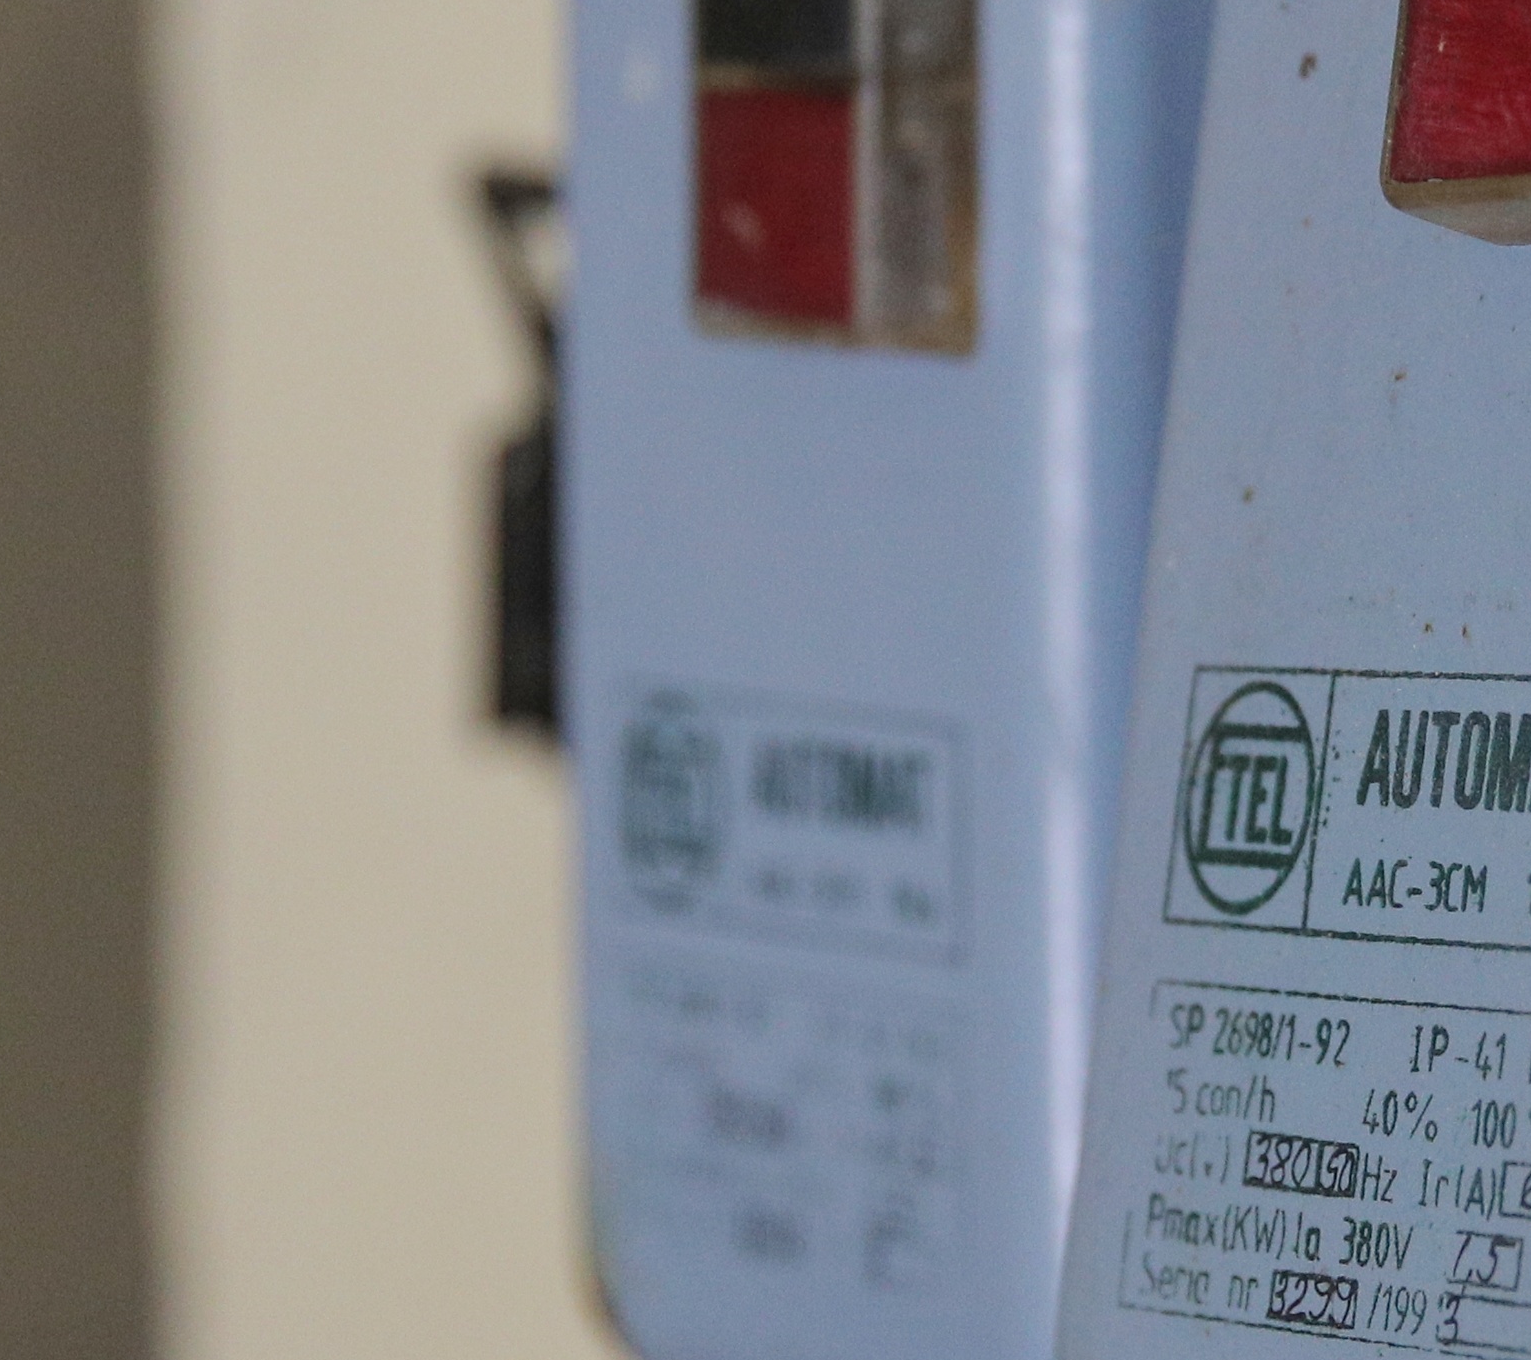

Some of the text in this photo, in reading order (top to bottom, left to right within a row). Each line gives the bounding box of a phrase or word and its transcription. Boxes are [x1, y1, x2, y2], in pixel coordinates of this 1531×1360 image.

[1342, 857, 1488, 914] AAC-3CM
[1169, 1002, 1206, 1050] SP
[1212, 1008, 1351, 1069] 2698/1-92
[1339, 1216, 1415, 1271] 380V
[1227, 1273, 1259, 1312] nr
